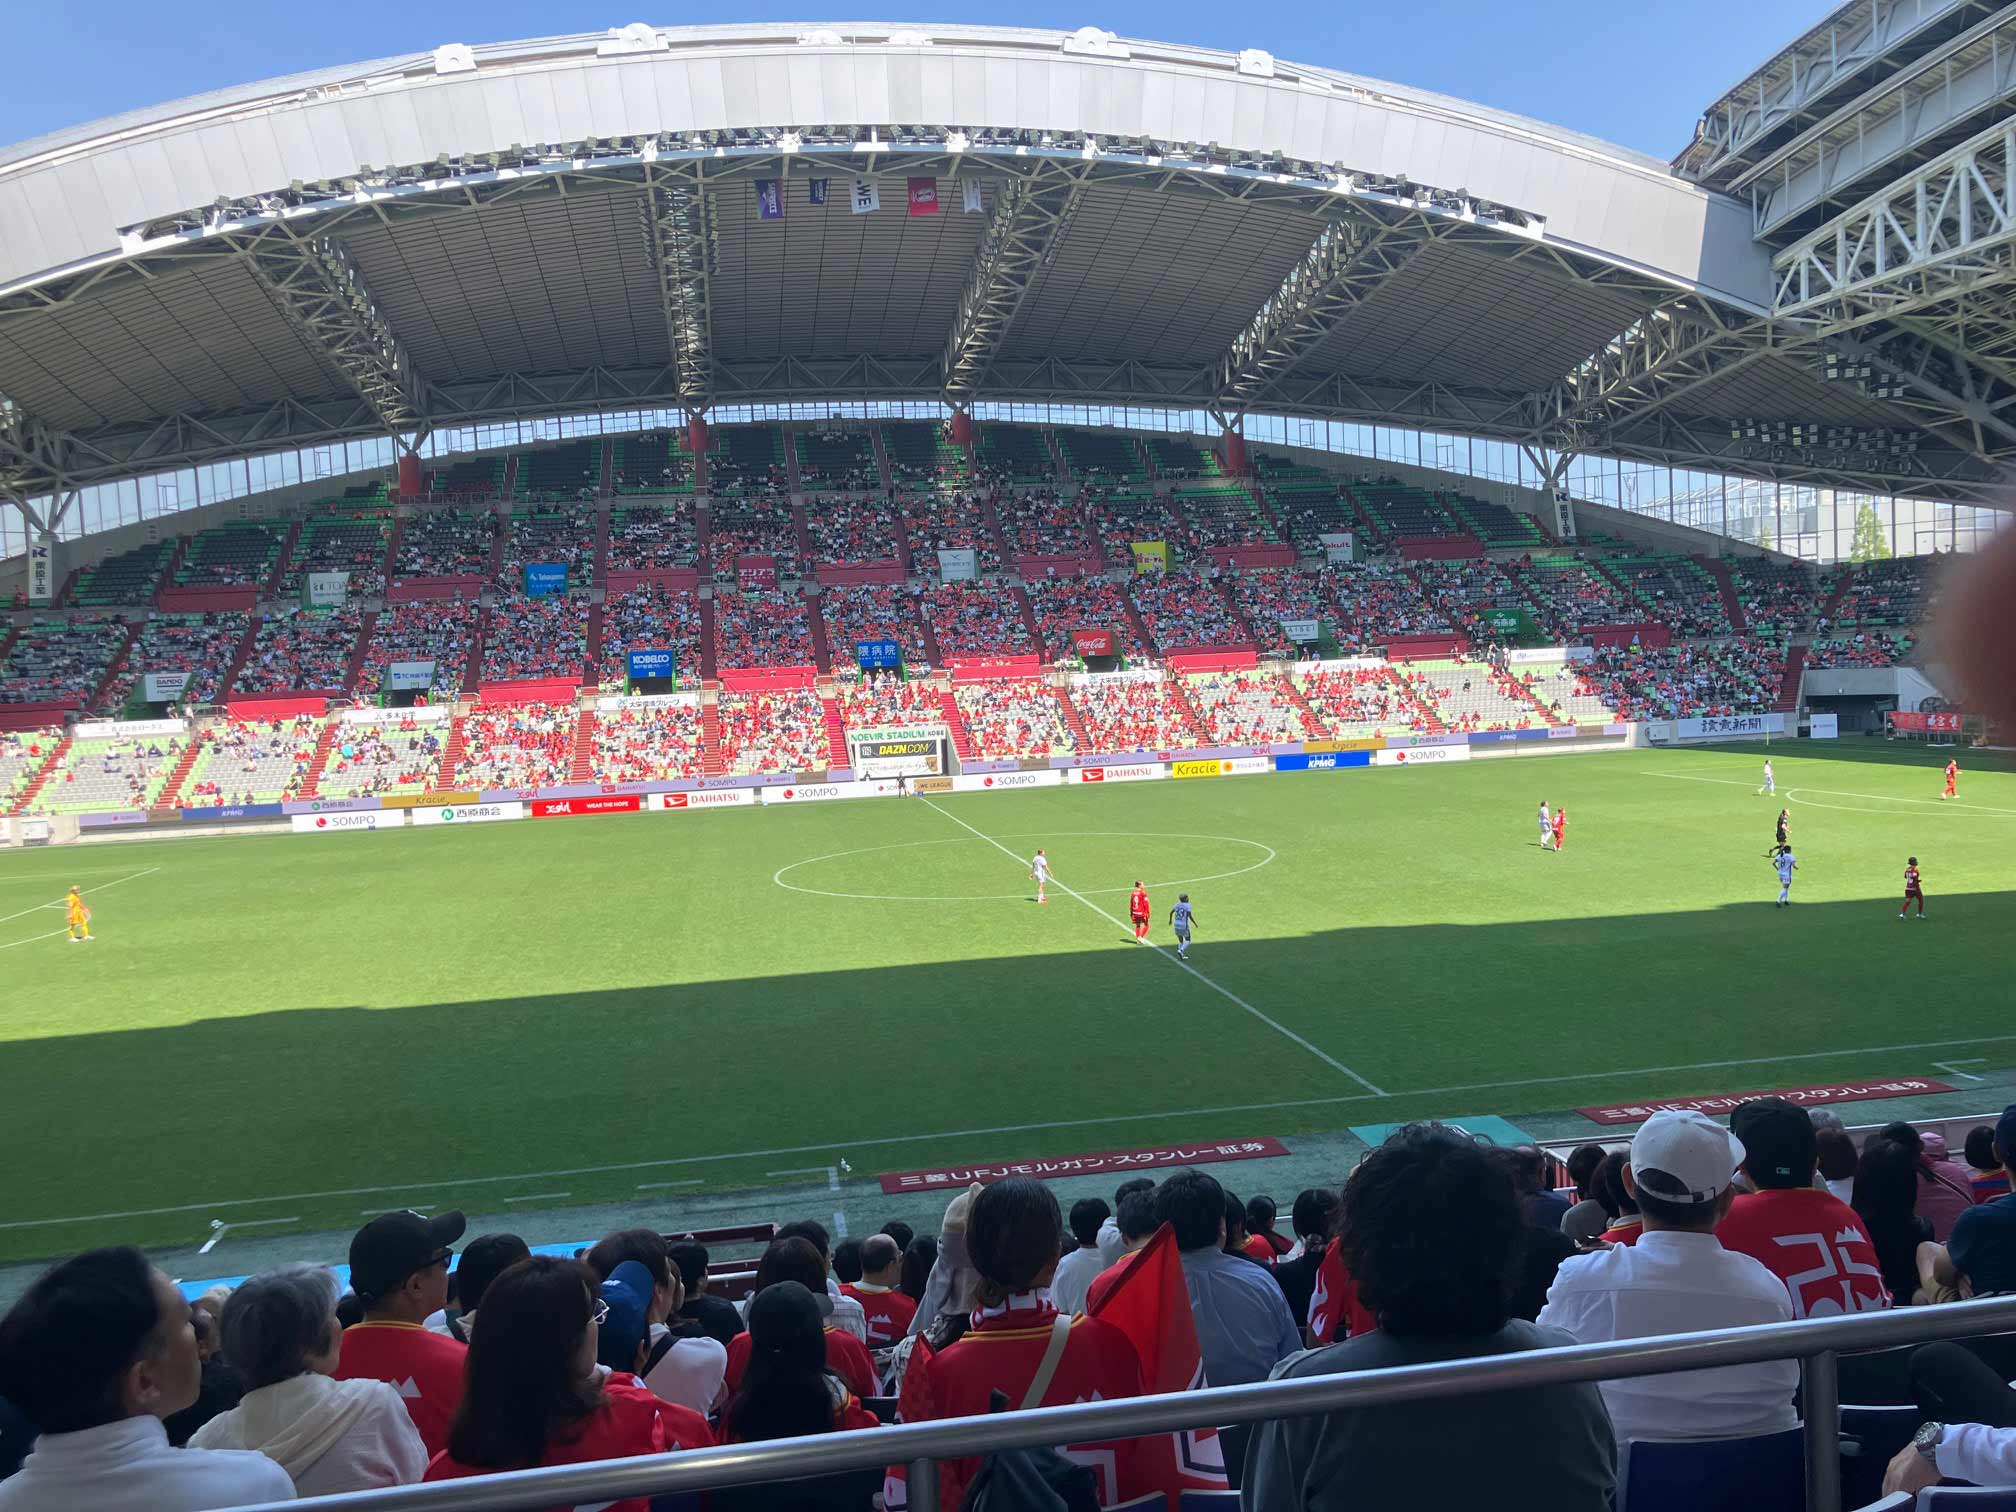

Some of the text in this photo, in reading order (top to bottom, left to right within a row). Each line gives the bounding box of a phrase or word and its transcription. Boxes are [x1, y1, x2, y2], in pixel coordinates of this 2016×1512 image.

[633, 654, 669, 664] KOBELCO
[851, 729, 944, 742] NOEVIR STADIUM KOBE
[1409, 750, 1446, 760] SOMPO
[1308, 757, 1336, 769] KPMG
[1106, 767, 1152, 778] DAIHATSU
[1176, 762, 1217, 776] Kracie
[708, 779, 737, 787] SOMPO
[997, 775, 1036, 786] SOMPO
[799, 787, 838, 798] SOMPO
[691, 793, 740, 804] DAIHATSU
[332, 815, 376, 827] SOMPO
